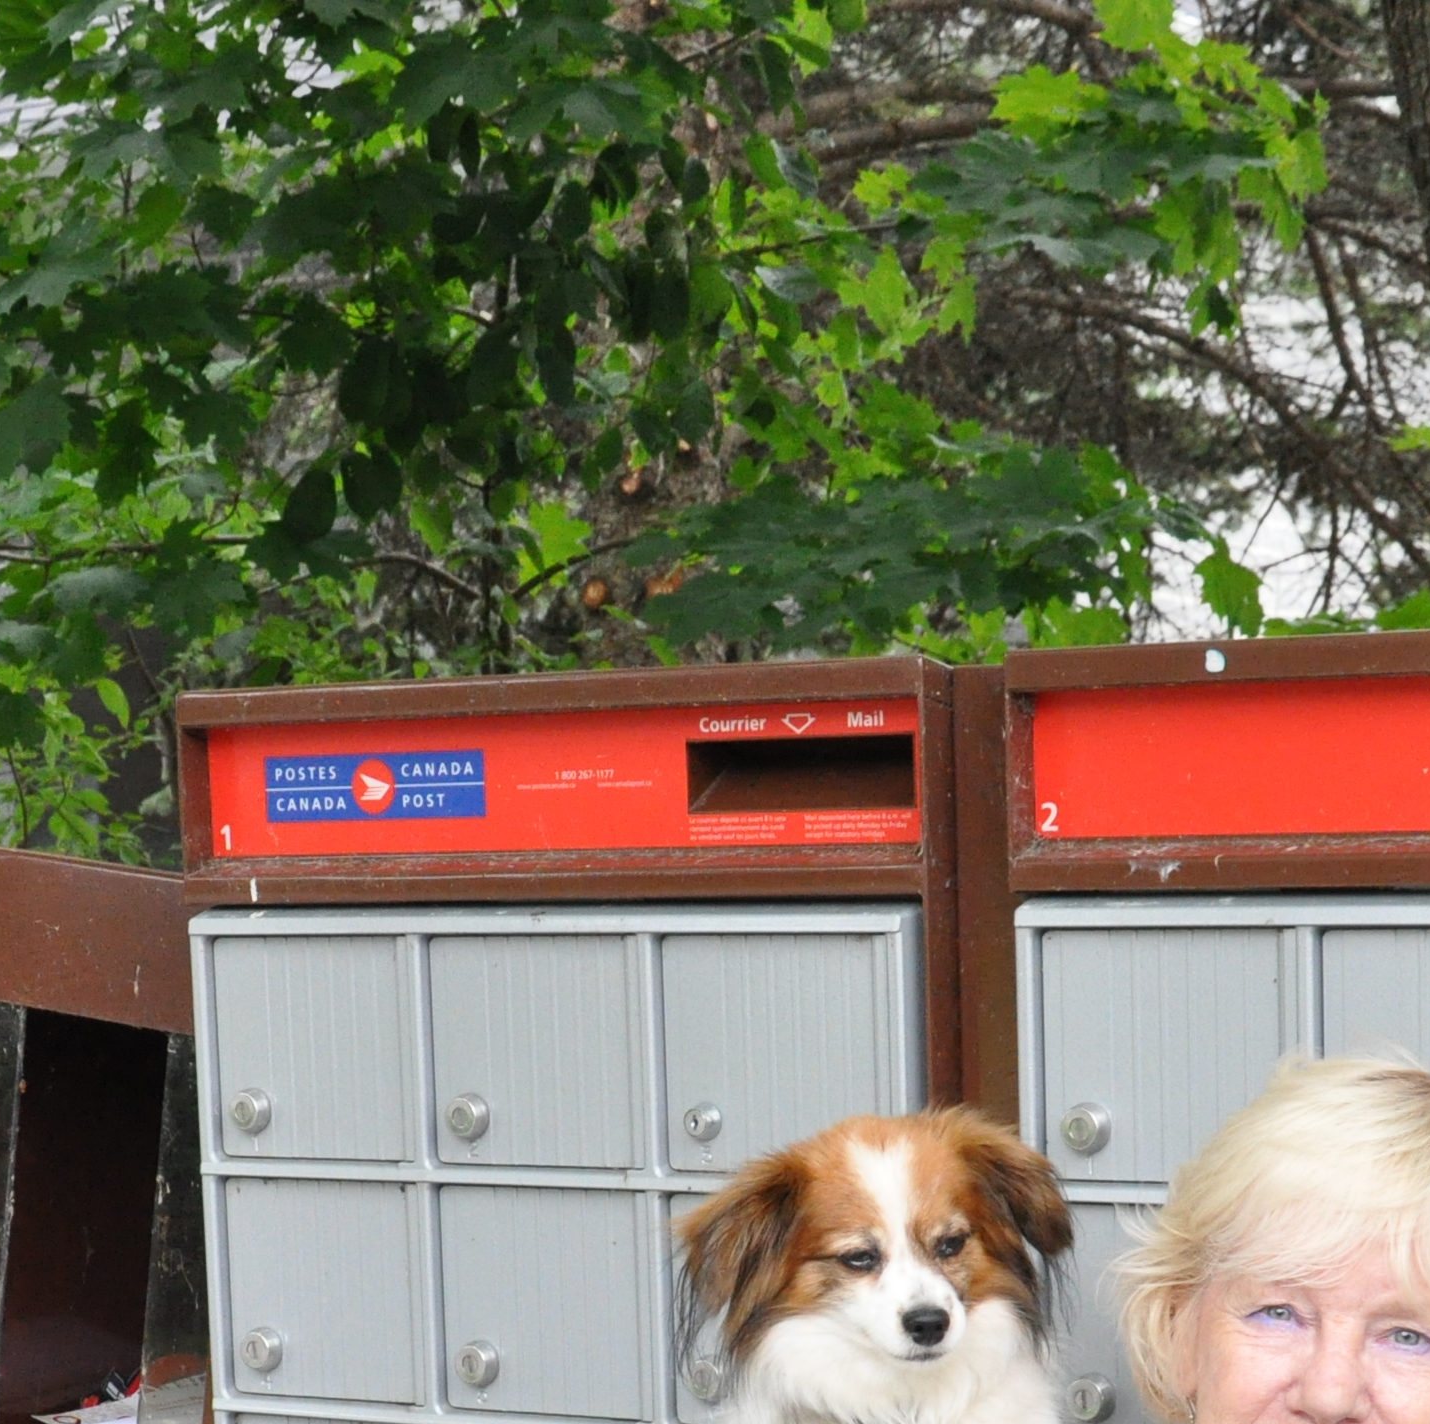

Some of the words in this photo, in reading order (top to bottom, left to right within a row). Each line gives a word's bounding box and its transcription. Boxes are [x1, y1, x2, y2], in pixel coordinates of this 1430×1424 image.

[699, 715, 767, 733] Courrier
[847, 710, 884, 728] Mail
[274, 766, 337, 781] POSTES
[400, 761, 474, 777] CANADA
[561, 770, 577, 780] 800
[578, 769, 615, 780] 267-1177
[276, 796, 347, 812] CANADA
[402, 793, 446, 808] POST
[1041, 801, 1059, 832] 2
[220, 824, 232, 851] 1
